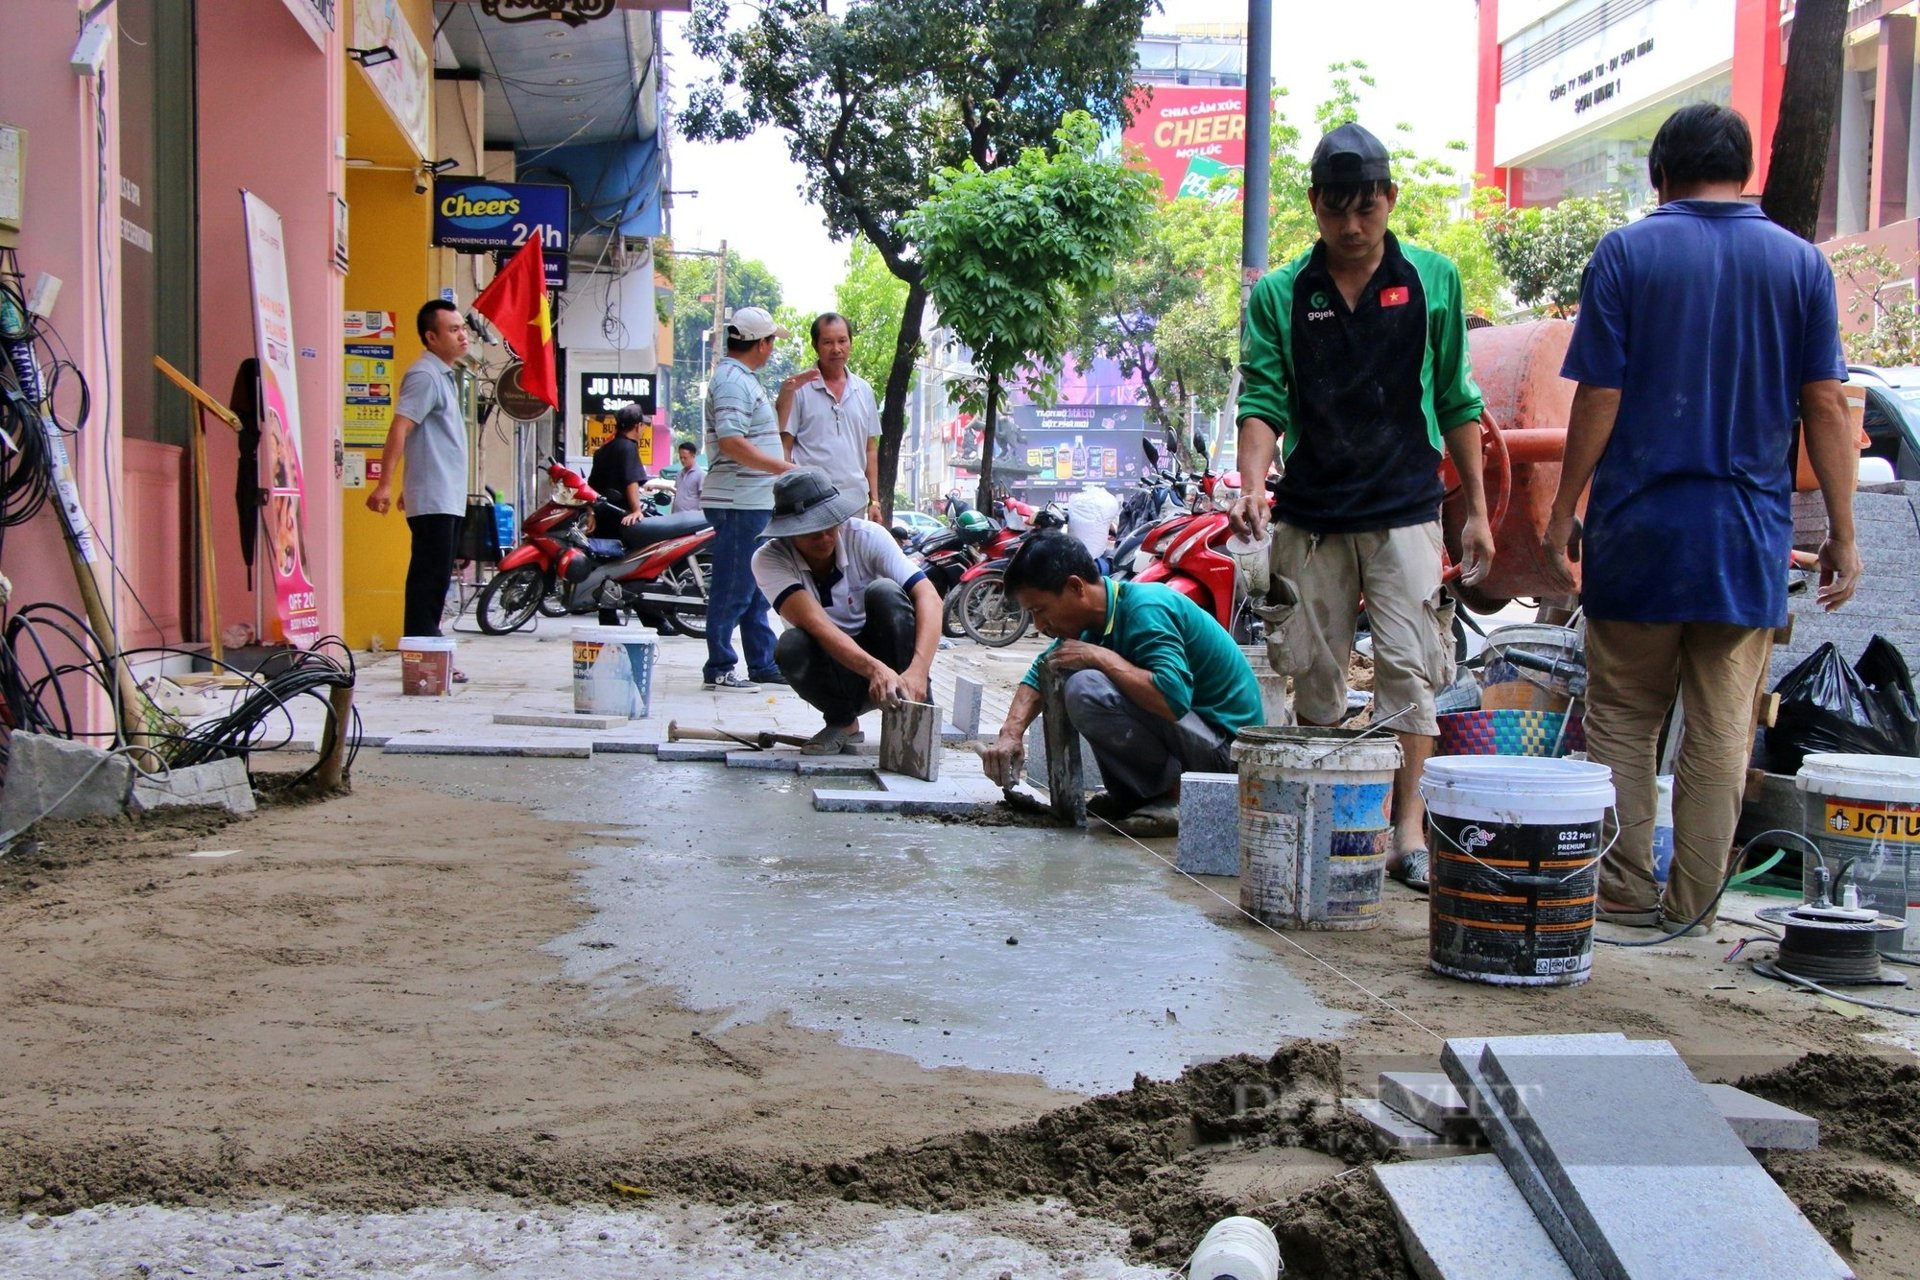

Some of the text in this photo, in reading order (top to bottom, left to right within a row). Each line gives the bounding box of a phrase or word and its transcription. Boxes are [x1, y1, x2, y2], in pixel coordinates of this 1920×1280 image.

[1568, 79, 1576, 92] TY
[1160, 99, 1242, 118] CHIA CẢM XÚC
[1199, 144, 1223, 155] LÚC
[441, 194, 520, 217] Cheers
[441, 236, 487, 245] CONVENIENCE
[1307, 310, 1335, 321] gojek
[587, 378, 650, 396] JU HAIR
[288, 592, 302, 610] OFF
[1558, 831, 1578, 841] G32
[1579, 832, 1592, 840] Plus
[1557, 843, 1586, 851] PREMIUM
